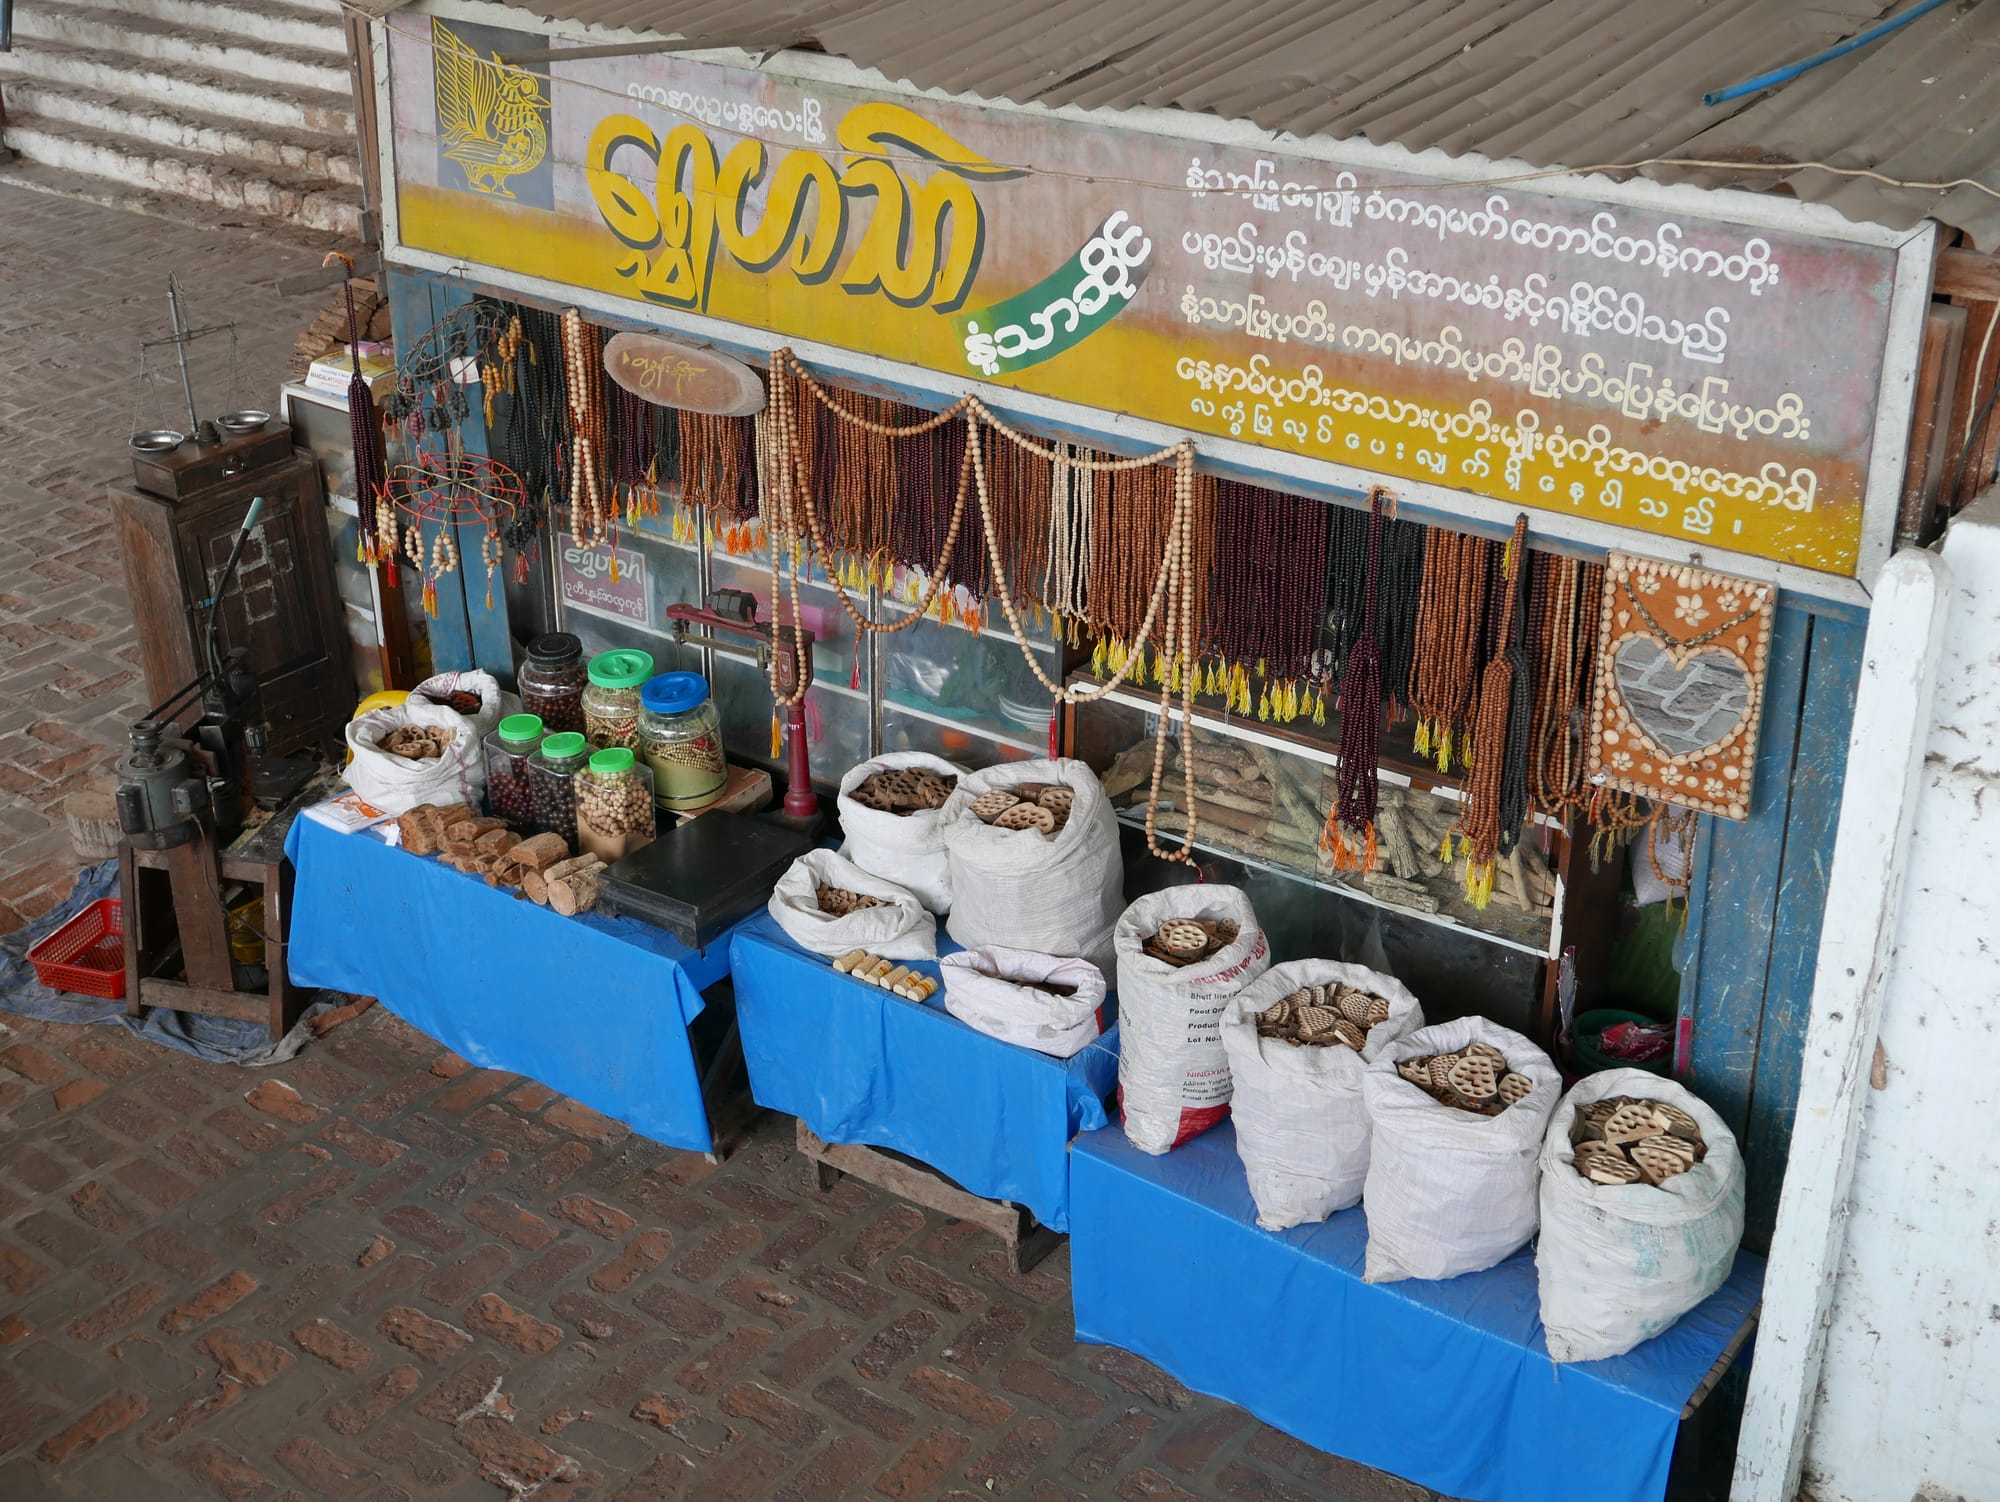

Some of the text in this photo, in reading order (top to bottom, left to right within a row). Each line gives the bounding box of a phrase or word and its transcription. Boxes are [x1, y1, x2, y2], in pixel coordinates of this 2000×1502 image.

[586, 102, 1032, 314] ရွှေဟင်္သာ
[964, 210, 1152, 376] နံ့သာဆိုင်
[1186, 1067, 1225, 1078] NINGXIA
